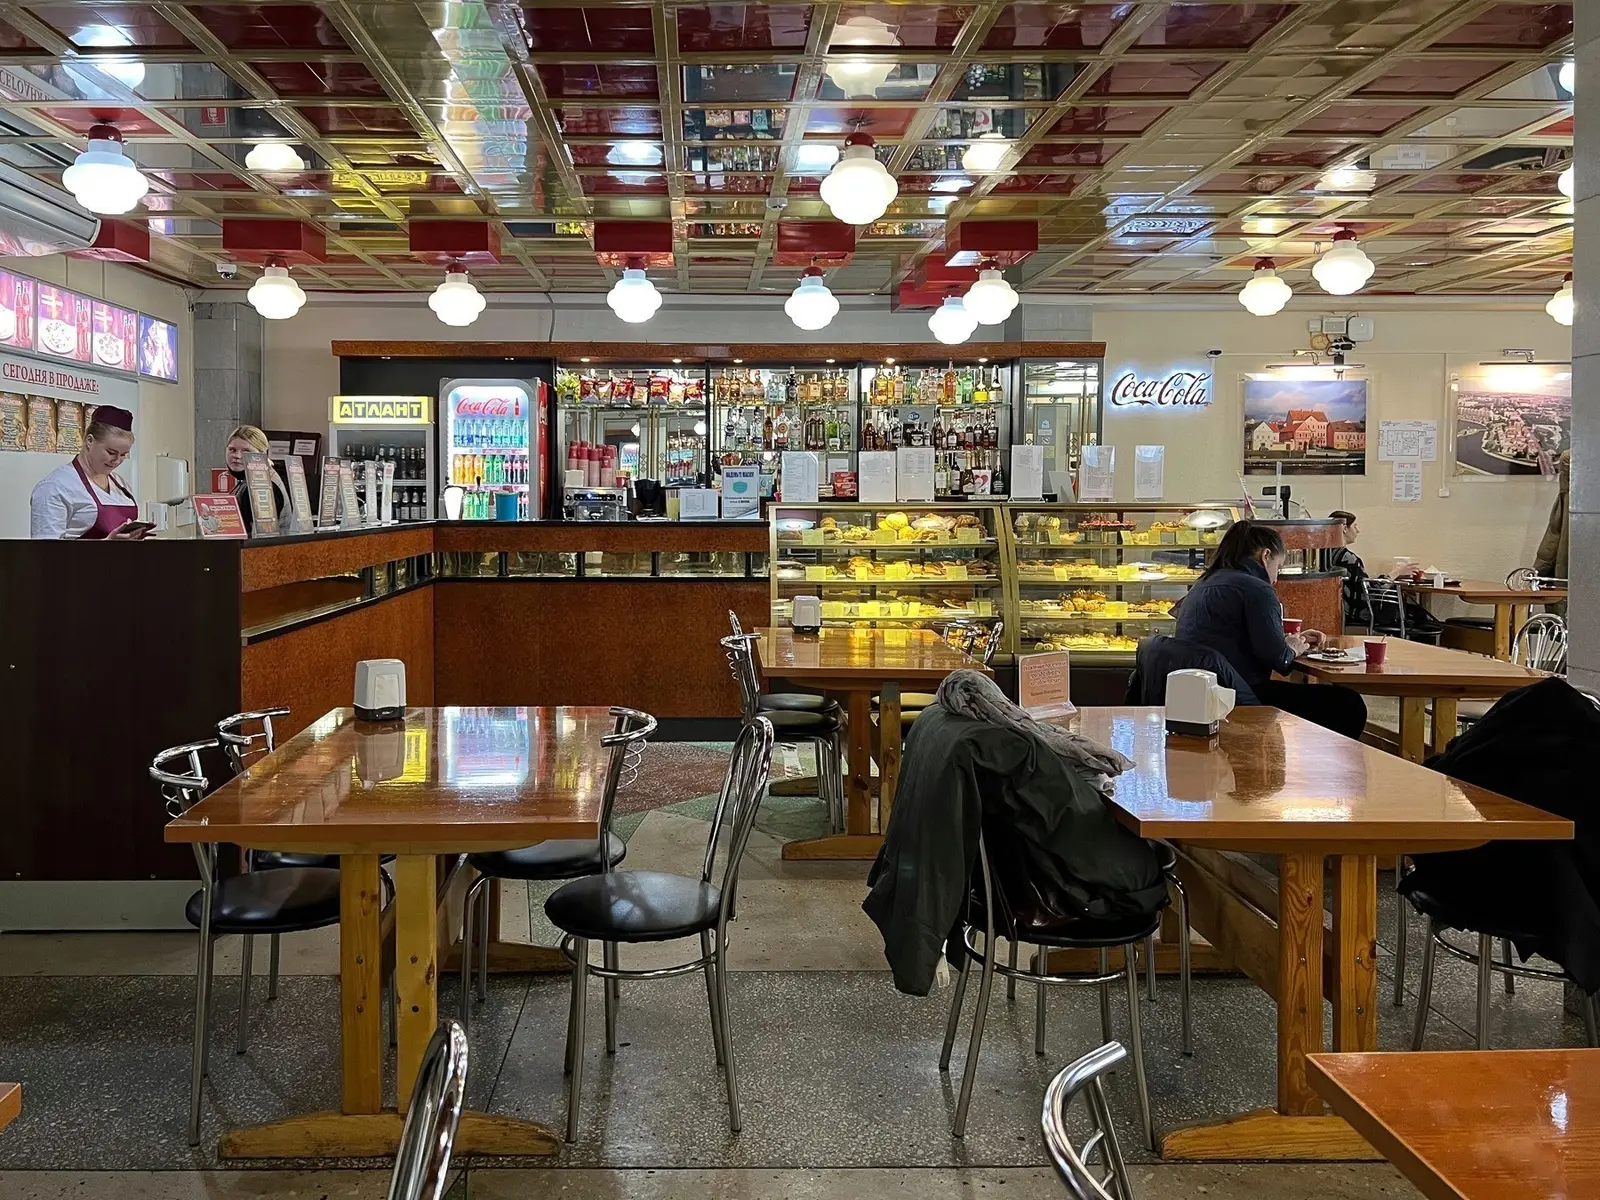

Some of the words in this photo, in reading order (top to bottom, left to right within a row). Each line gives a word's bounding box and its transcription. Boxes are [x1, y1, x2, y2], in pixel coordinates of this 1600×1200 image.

[3, 363, 48, 384] СЕГОДНЯ
[49, 372, 55, 385] В
[56, 373, 99, 392] ПРОДАЖЕ:
[1111, 372, 1213, 407] Coca-Cola
[340, 402, 422, 418] АТЛАНТ
[456, 397, 510, 416] Coca-Cola
